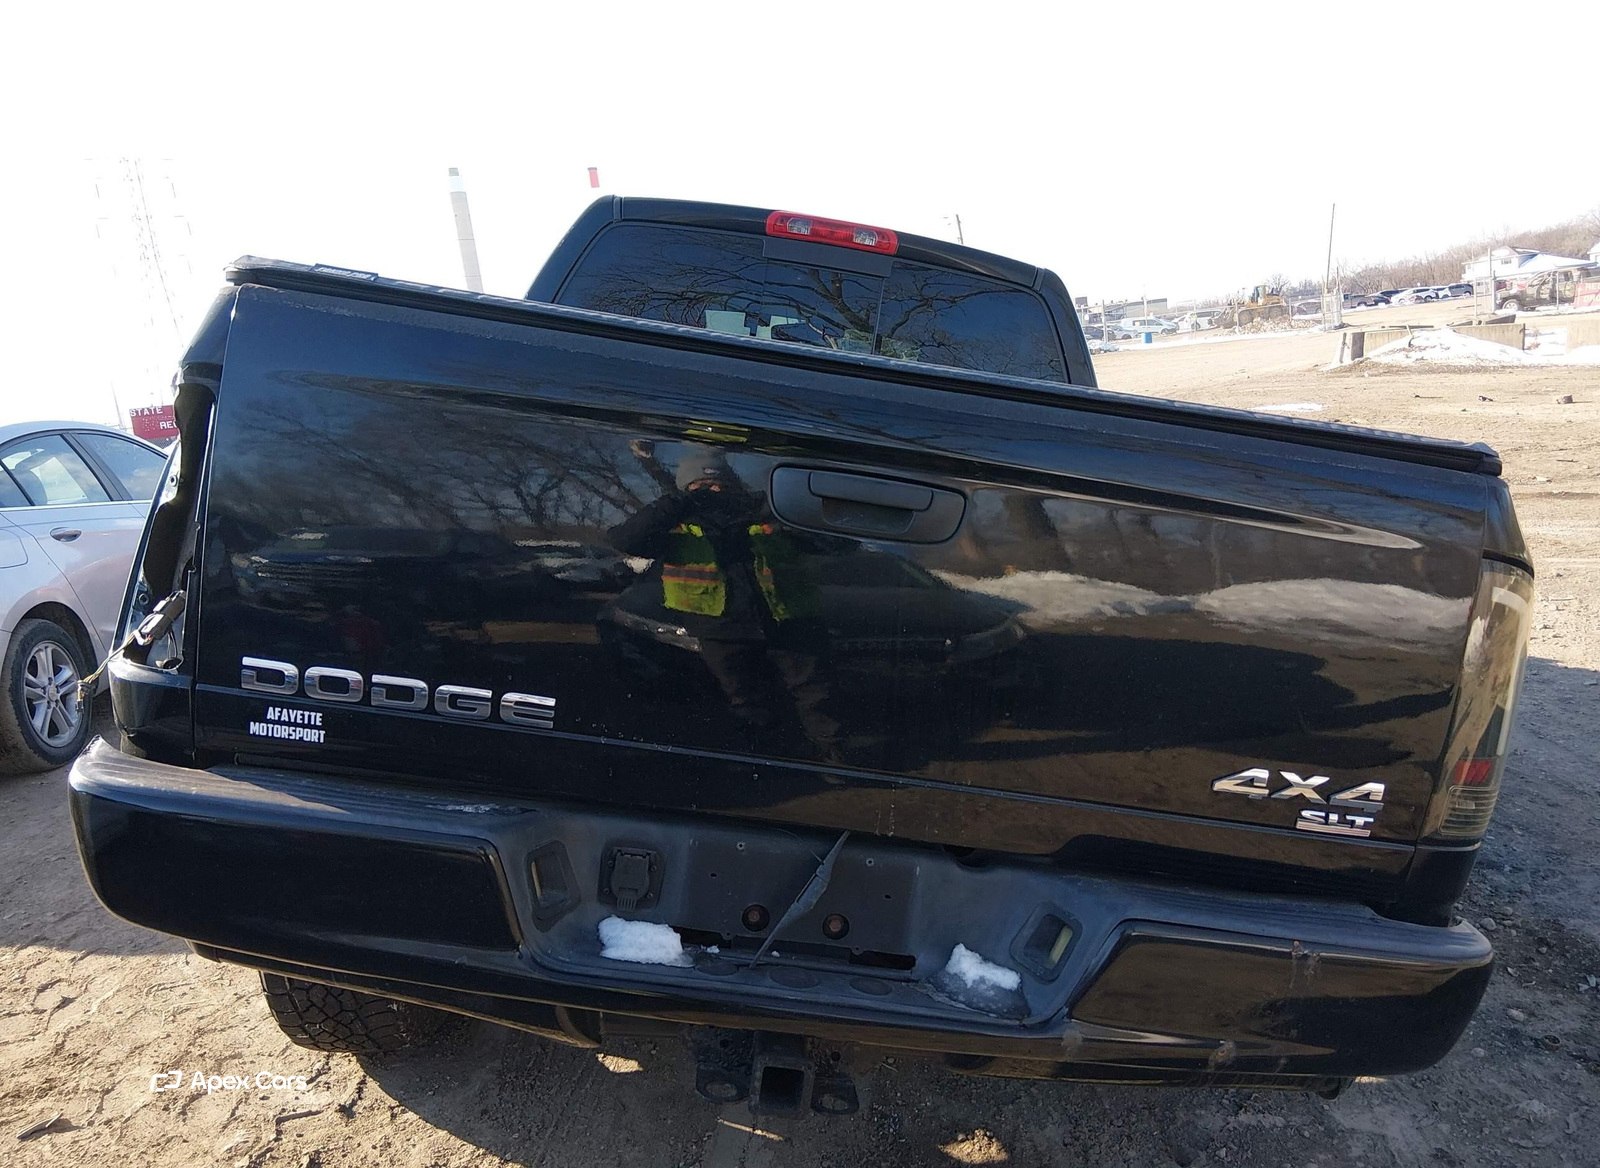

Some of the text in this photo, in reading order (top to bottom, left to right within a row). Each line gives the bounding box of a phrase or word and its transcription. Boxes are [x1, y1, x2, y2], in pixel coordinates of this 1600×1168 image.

[129, 406, 163, 416] STATE
[241, 656, 557, 729] DODGE
[266, 706, 323, 726] AFAYETTE
[249, 721, 326, 743] MOTORSPORT
[1297, 809, 1375, 829] SLT
